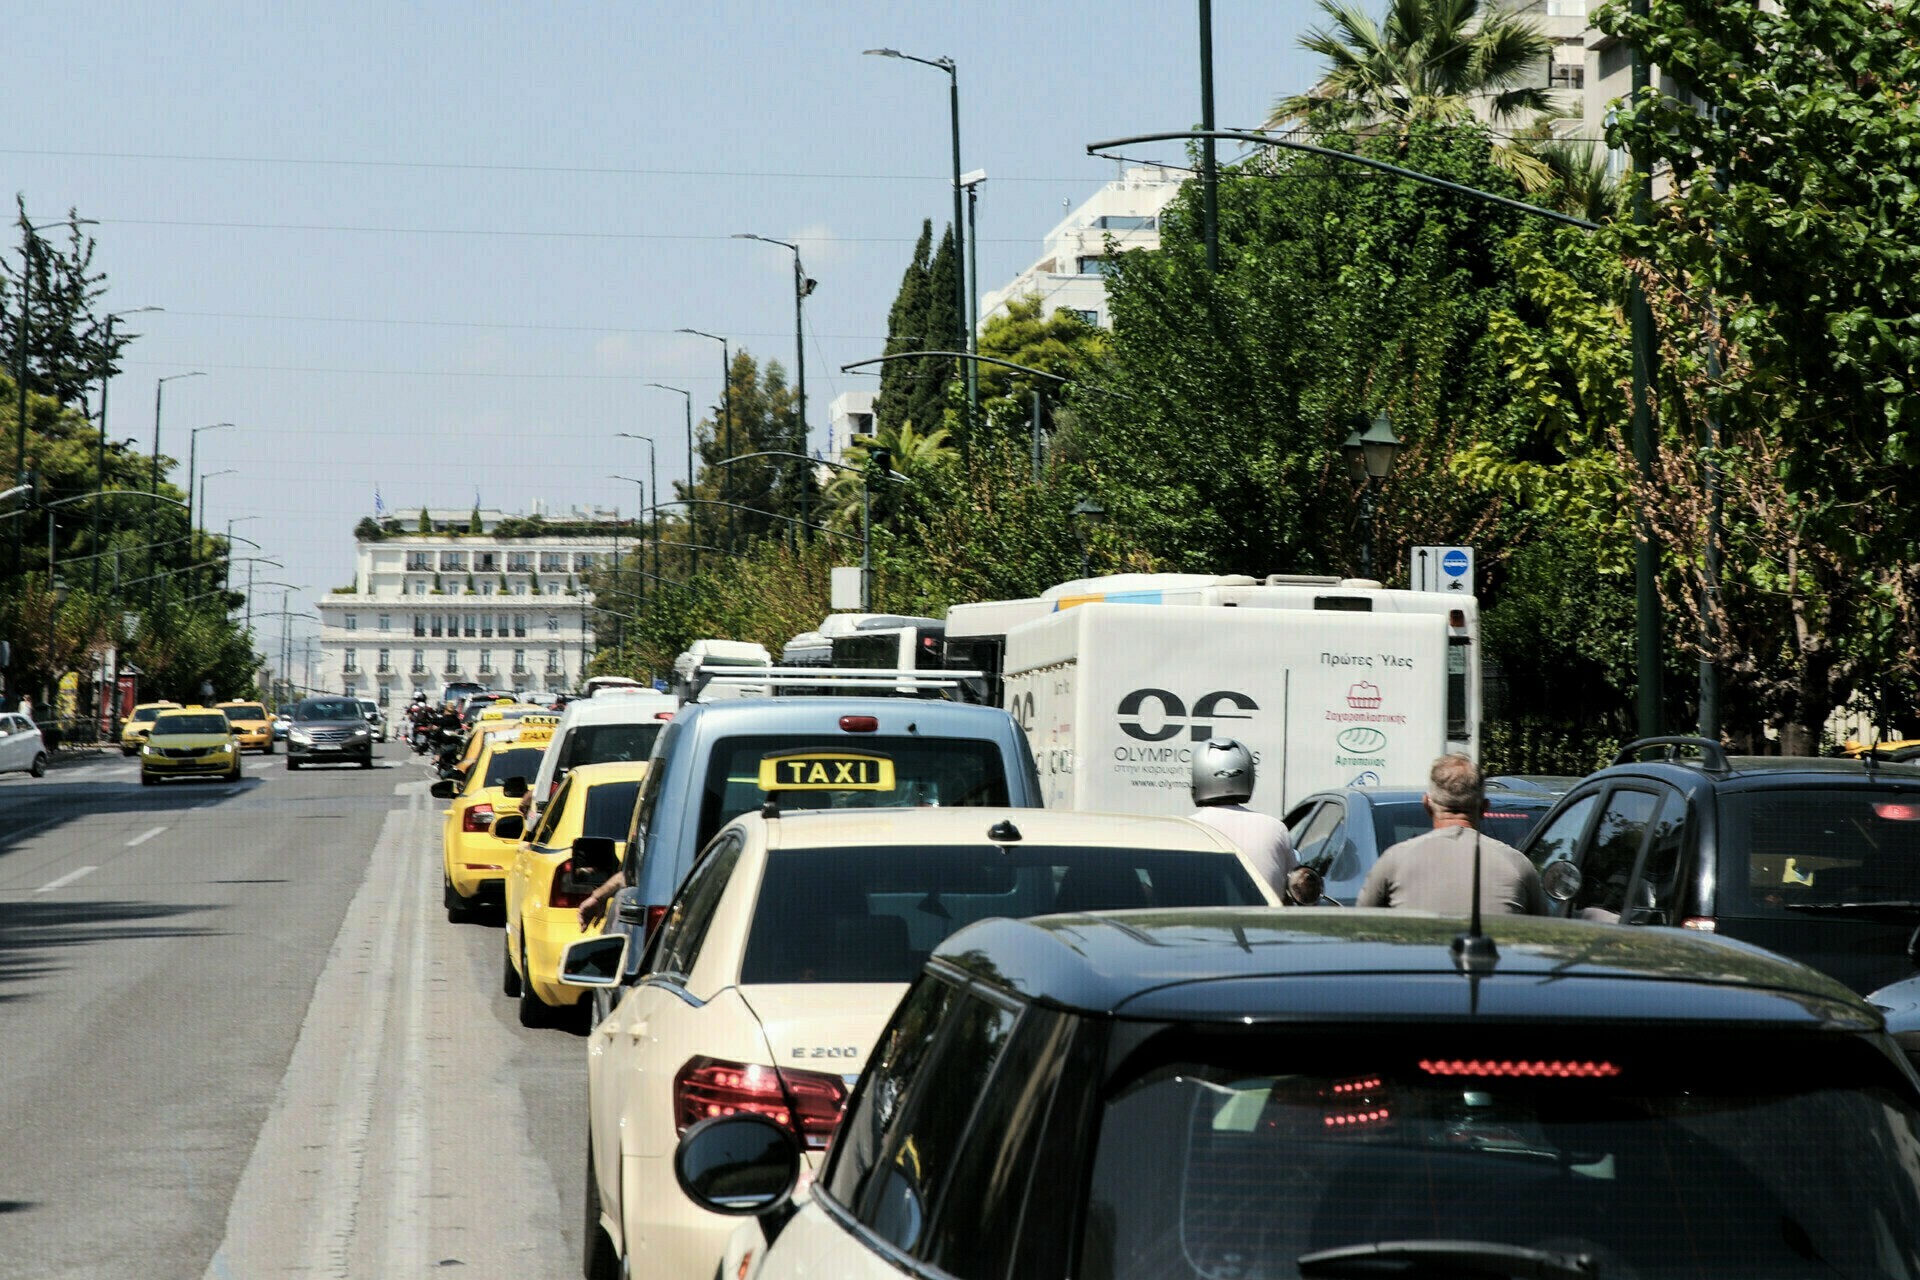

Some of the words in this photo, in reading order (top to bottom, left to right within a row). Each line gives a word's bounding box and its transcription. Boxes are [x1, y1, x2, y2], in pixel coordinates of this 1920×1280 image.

[1320, 652, 1374, 668] Πρώτες
[1114, 746, 1192, 763] OLYMPIC
[787, 761, 868, 784] TAXI
[791, 1047, 806, 1058] E
[811, 1047, 858, 1059] 200
